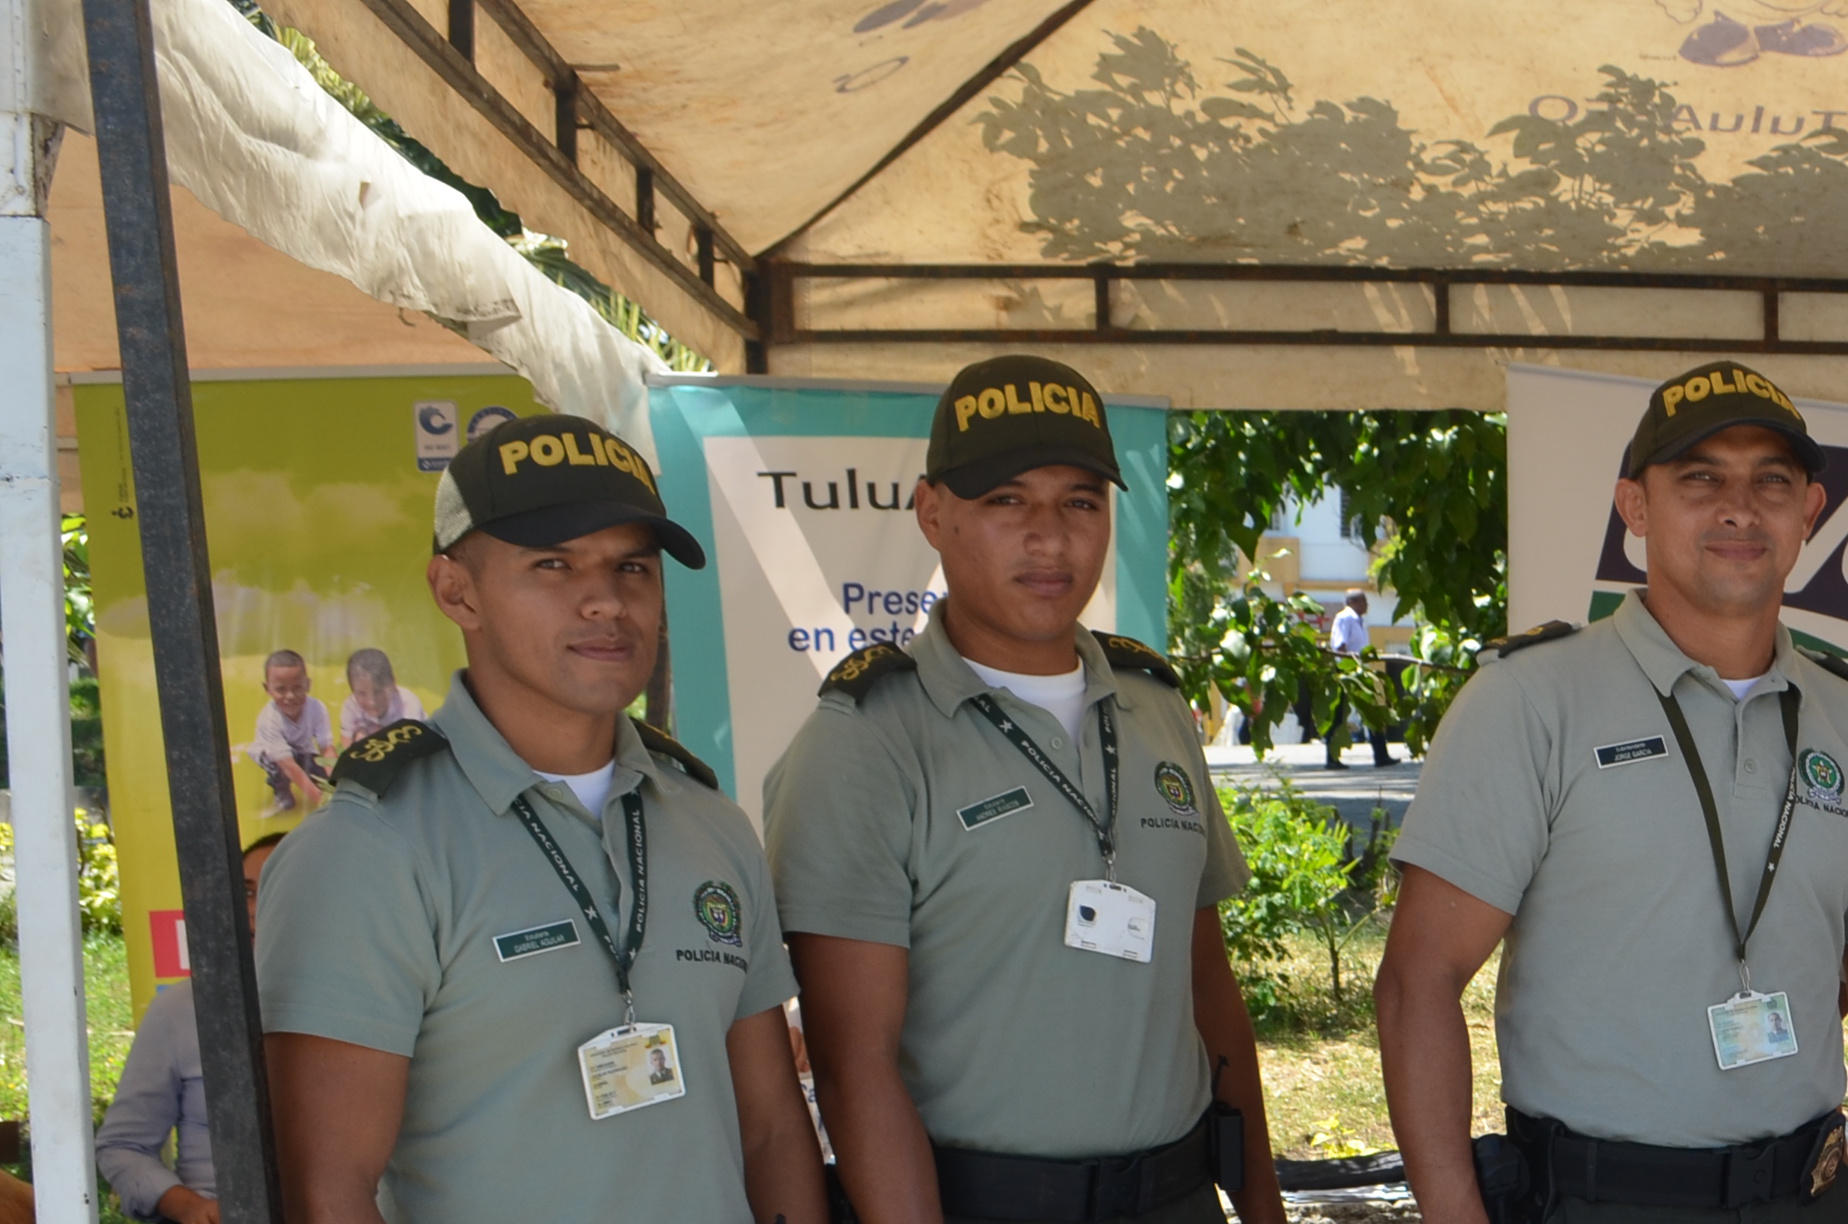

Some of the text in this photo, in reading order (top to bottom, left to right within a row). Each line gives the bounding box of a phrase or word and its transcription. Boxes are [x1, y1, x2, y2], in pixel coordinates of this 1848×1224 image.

[953, 381, 1101, 433] POLICIA
[1663, 367, 1802, 420] POLICIA
[499, 431, 657, 496] POLICIA
[842, 581, 949, 616] Prese
[787, 626, 835, 652] en
[1021, 739, 1061, 783] POLICIA
[1140, 817, 1180, 830] POLICIA
[1773, 801, 1793, 849] NACIONAL
[530, 820, 580, 893] NACIONAL
[631, 808, 648, 935] POLICIA NACIONAL
[676, 949, 721, 963] POLICIA
